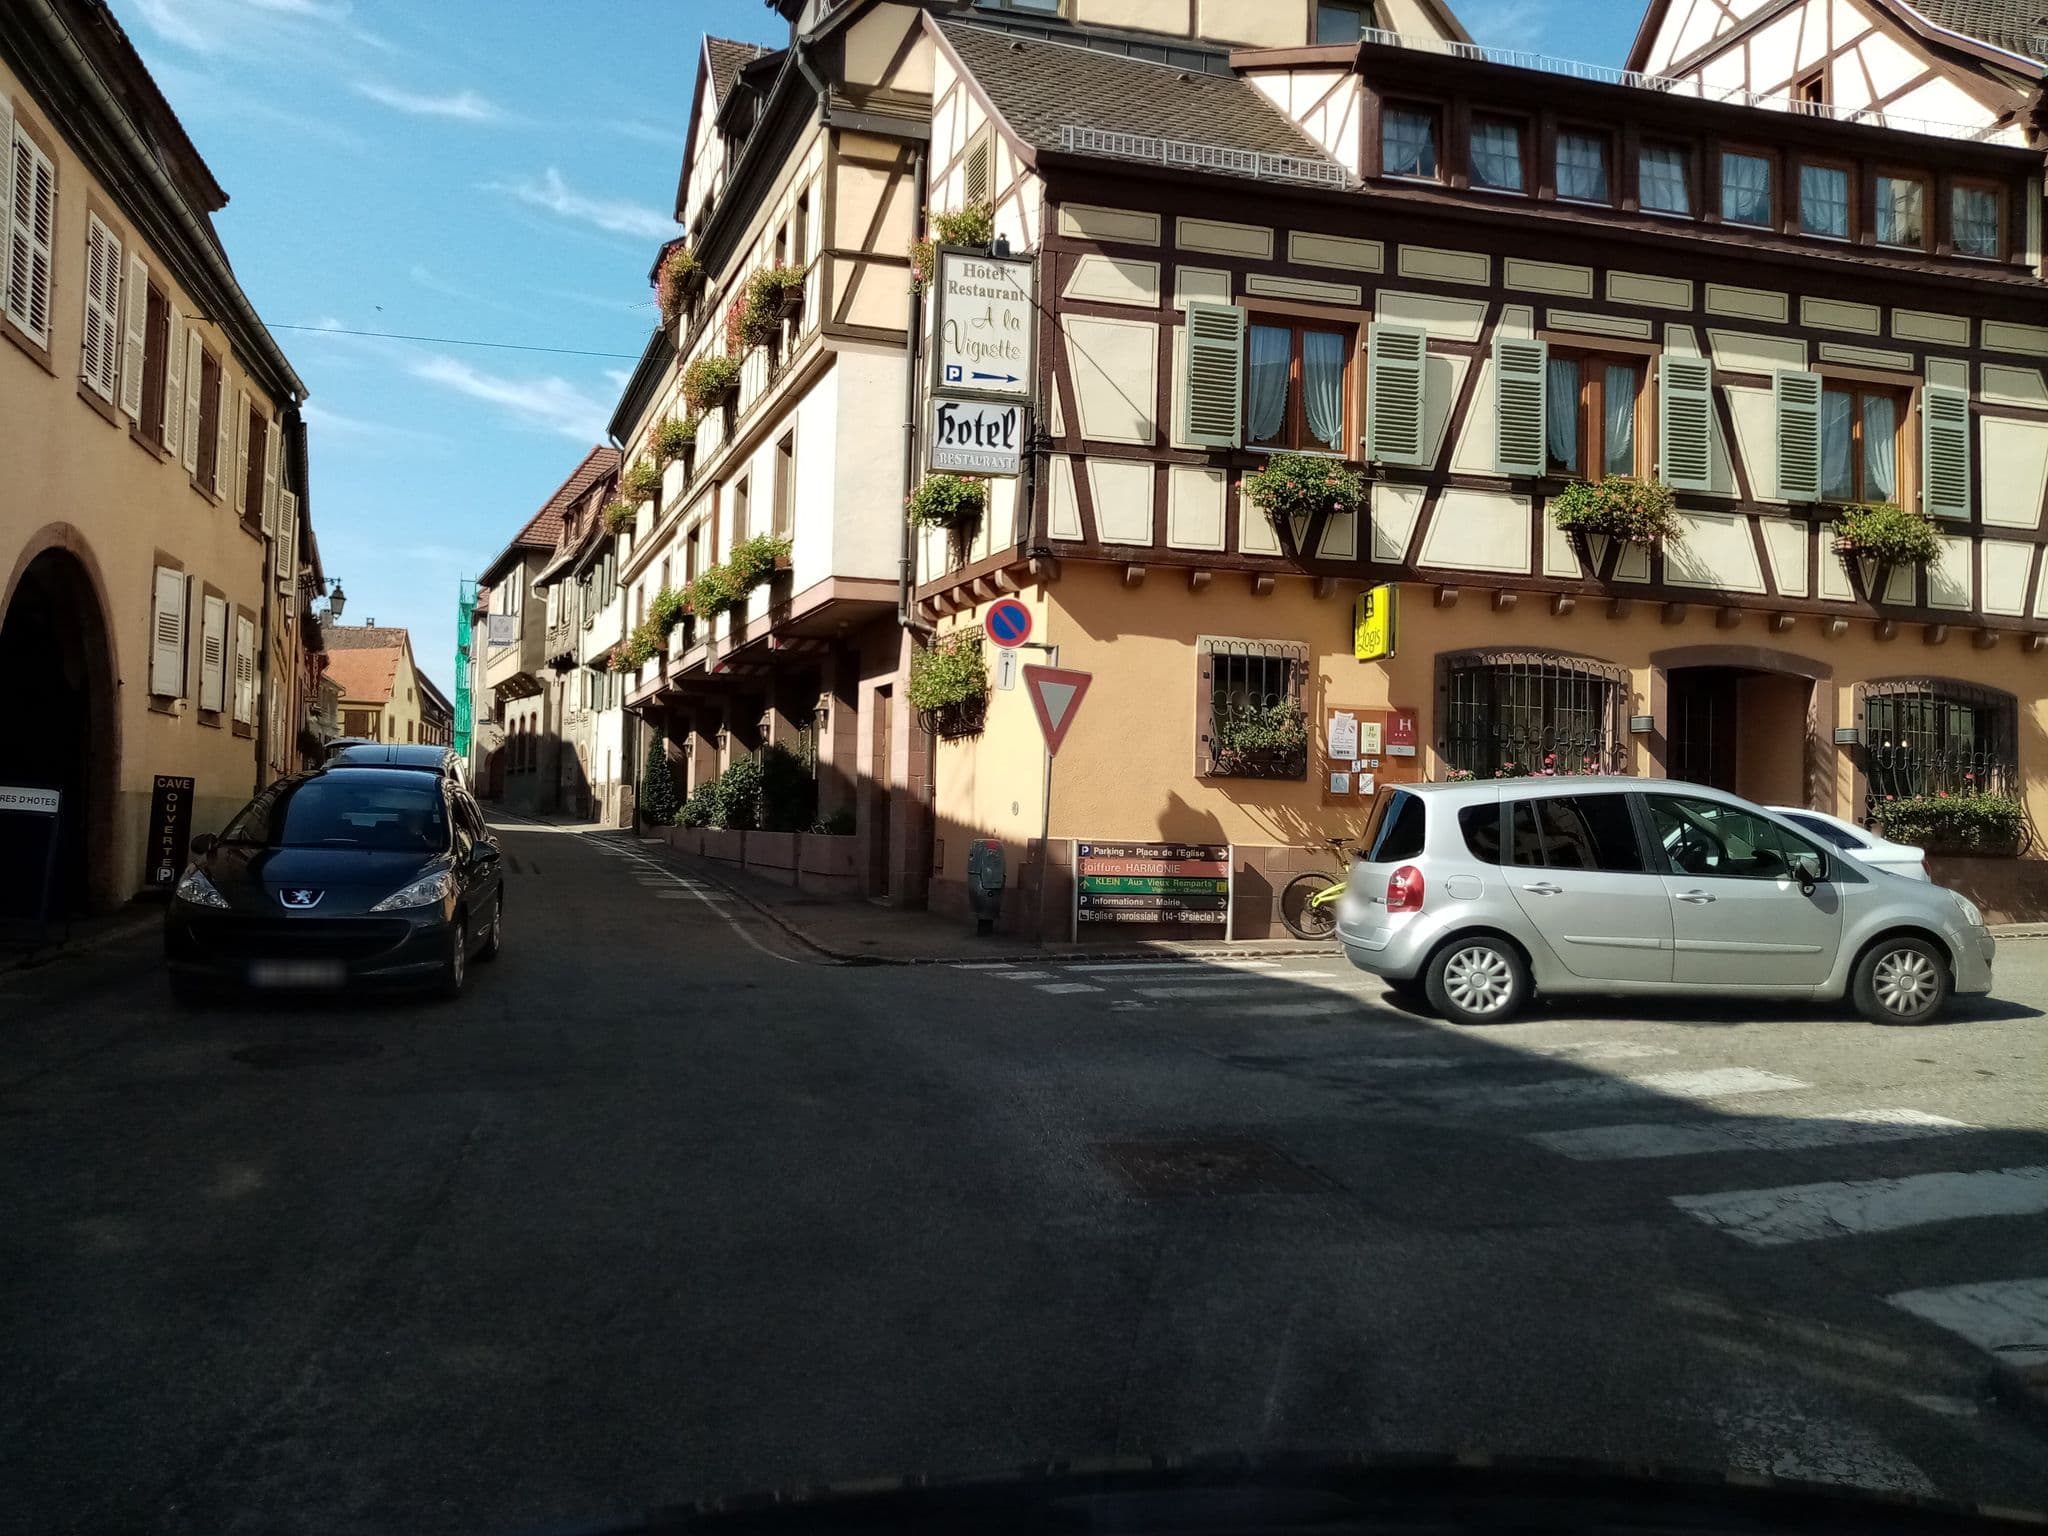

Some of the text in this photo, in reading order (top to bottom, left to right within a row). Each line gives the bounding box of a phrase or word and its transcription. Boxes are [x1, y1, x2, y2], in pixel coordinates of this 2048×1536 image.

[963, 263, 1005, 281] Hôtel
[948, 280, 1025, 302] Restaurant
[1003, 309, 1021, 330] la
[942, 319, 1021, 363] Vignette
[947, 366, 961, 381] P
[938, 452, 1016, 469] RESTAURANT
[1357, 621, 1381, 653] Logis
[157, 778, 191, 789] CAVE
[162, 793, 178, 867] OUVERTE
[1094, 847, 1124, 856] Parking
[1136, 848, 1159, 856] Place
[1162, 849, 1173, 857] de
[1080, 863, 1180, 873] Coiffure HARMONIE
[1096, 877, 1120, 886] KLEIN
[1148, 879, 1169, 887] Vieux
[1092, 897, 1144, 906] Informations
[1156, 898, 1181, 906] Mairie
[1116, 911, 1159, 922] paroissiale
